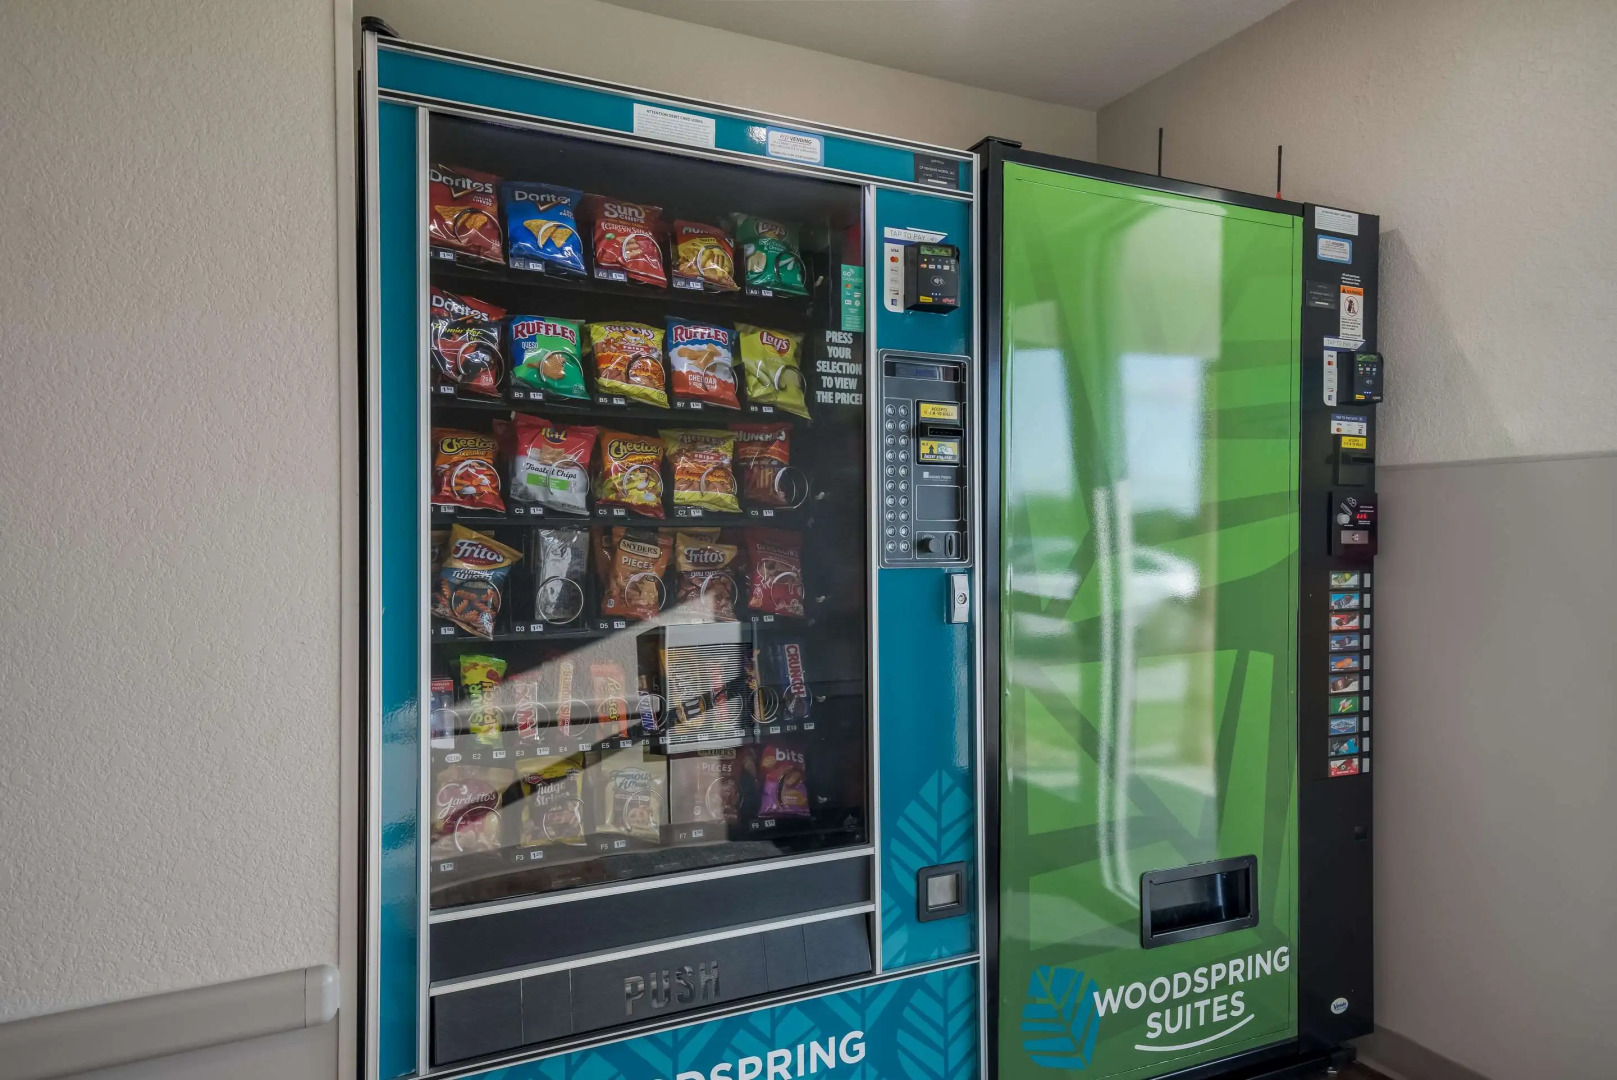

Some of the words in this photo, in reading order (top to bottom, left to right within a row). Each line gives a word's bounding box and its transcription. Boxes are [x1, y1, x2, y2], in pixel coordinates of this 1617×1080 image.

[430, 169, 494, 194] Doritos
[603, 202, 642, 220] Sun
[889, 230, 902, 238] TAP
[904, 231, 912, 240] TO
[913, 233, 926, 242] PAY
[513, 319, 577, 347] RUFFLES
[673, 324, 729, 346] RUFFLES
[826, 330, 854, 345] PRESS
[521, 342, 539, 351] QUESO
[760, 331, 790, 352] Lay's
[827, 345, 852, 360] YOUR
[816, 360, 863, 376] SELECTION
[821, 375, 834, 389] TO
[834, 376, 858, 391] VIEW
[514, 390, 524, 398] B3
[816, 391, 834, 404] THE
[835, 392, 863, 406] PRICE!
[441, 436, 498, 455] Cheetos
[554, 468, 578, 481] Chips
[453, 540, 505, 563] Fritos
[621, 540, 659, 556] SNYDER'S
[683, 546, 725, 563] Fritos
[621, 556, 654, 570] PIECES
[786, 644, 807, 696] CRUNCH
[468, 683, 484, 725] SOUR
[482, 681, 497, 726] PATCH
[516, 749, 525, 757] E3
[775, 747, 805, 764] bits
[702, 762, 733, 773] PIECES
[679, 832, 687, 840] F7
[515, 854, 525, 862] F3
[624, 959, 720, 1016] PUSH
[1092, 945, 1290, 1018] WOODSPRING
[1145, 990, 1246, 1039] SUITES
